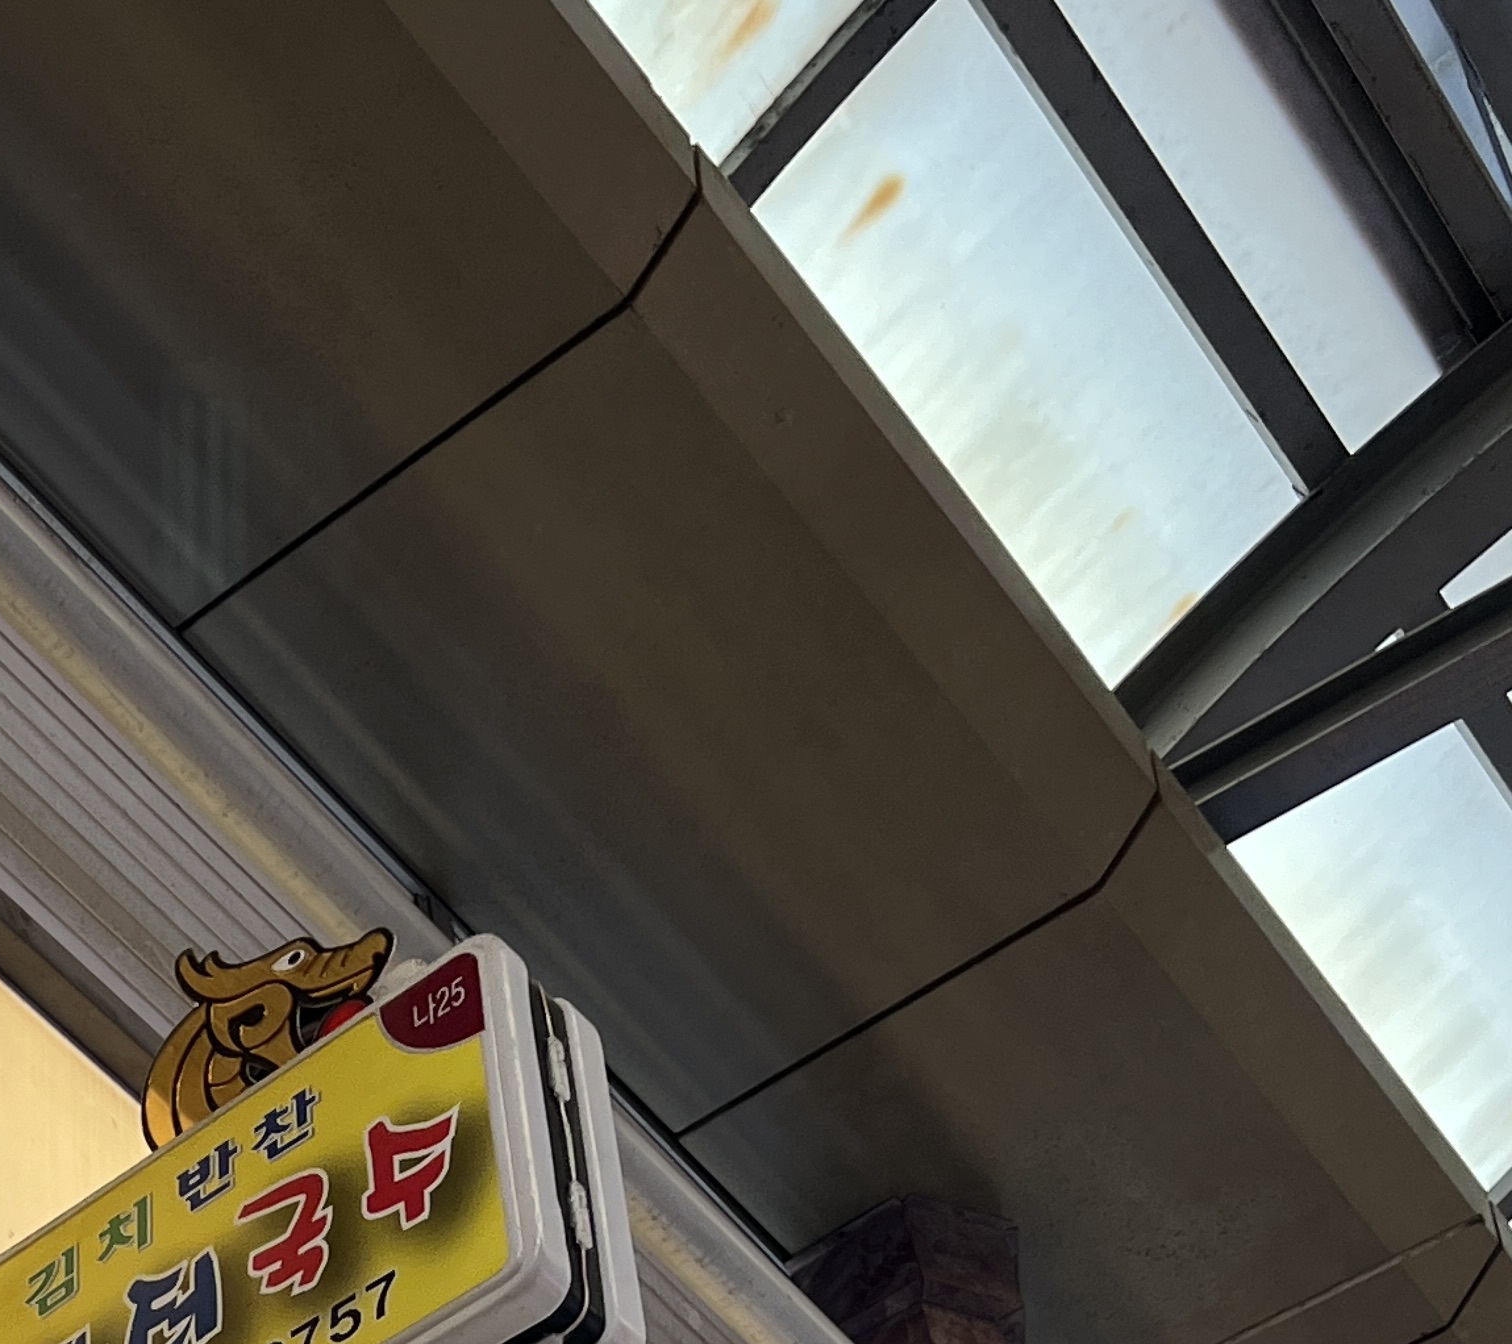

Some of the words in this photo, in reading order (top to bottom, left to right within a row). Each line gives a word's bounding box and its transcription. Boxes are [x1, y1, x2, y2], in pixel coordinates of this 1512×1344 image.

[412, 976, 466, 1028] 나25
[24, 1192, 153, 1319] 김치
[175, 1084, 321, 1213] 반찬
